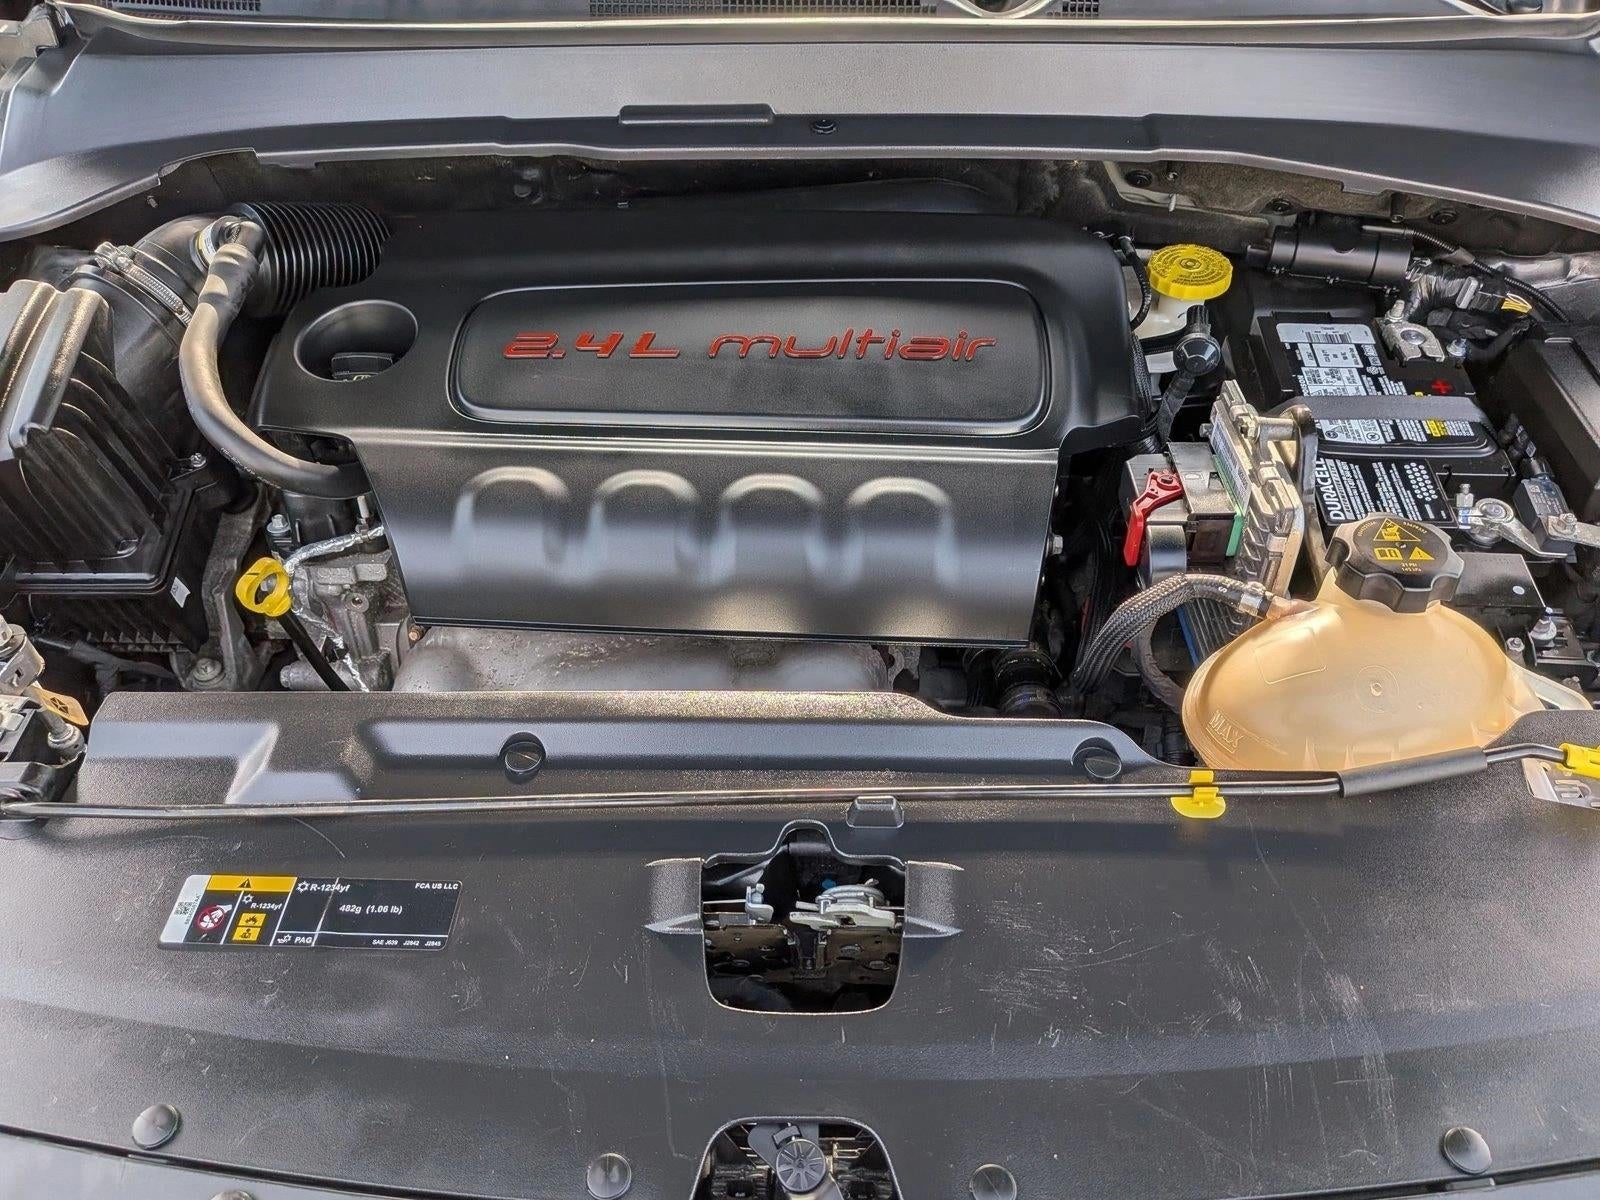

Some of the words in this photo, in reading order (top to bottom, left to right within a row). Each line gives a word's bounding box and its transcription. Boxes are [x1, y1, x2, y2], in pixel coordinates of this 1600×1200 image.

[708, 328, 997, 361] multiair
[1314, 457, 1346, 520] DURACELL
[310, 883, 350, 893] R-1234yf
[415, 882, 431, 890] FCA
[250, 902, 282, 910] R-1234yf
[339, 904, 362, 915] 482g
[366, 905, 389, 915] (1.06
[390, 905, 403, 916] lb)
[294, 936, 313, 944] PAG
